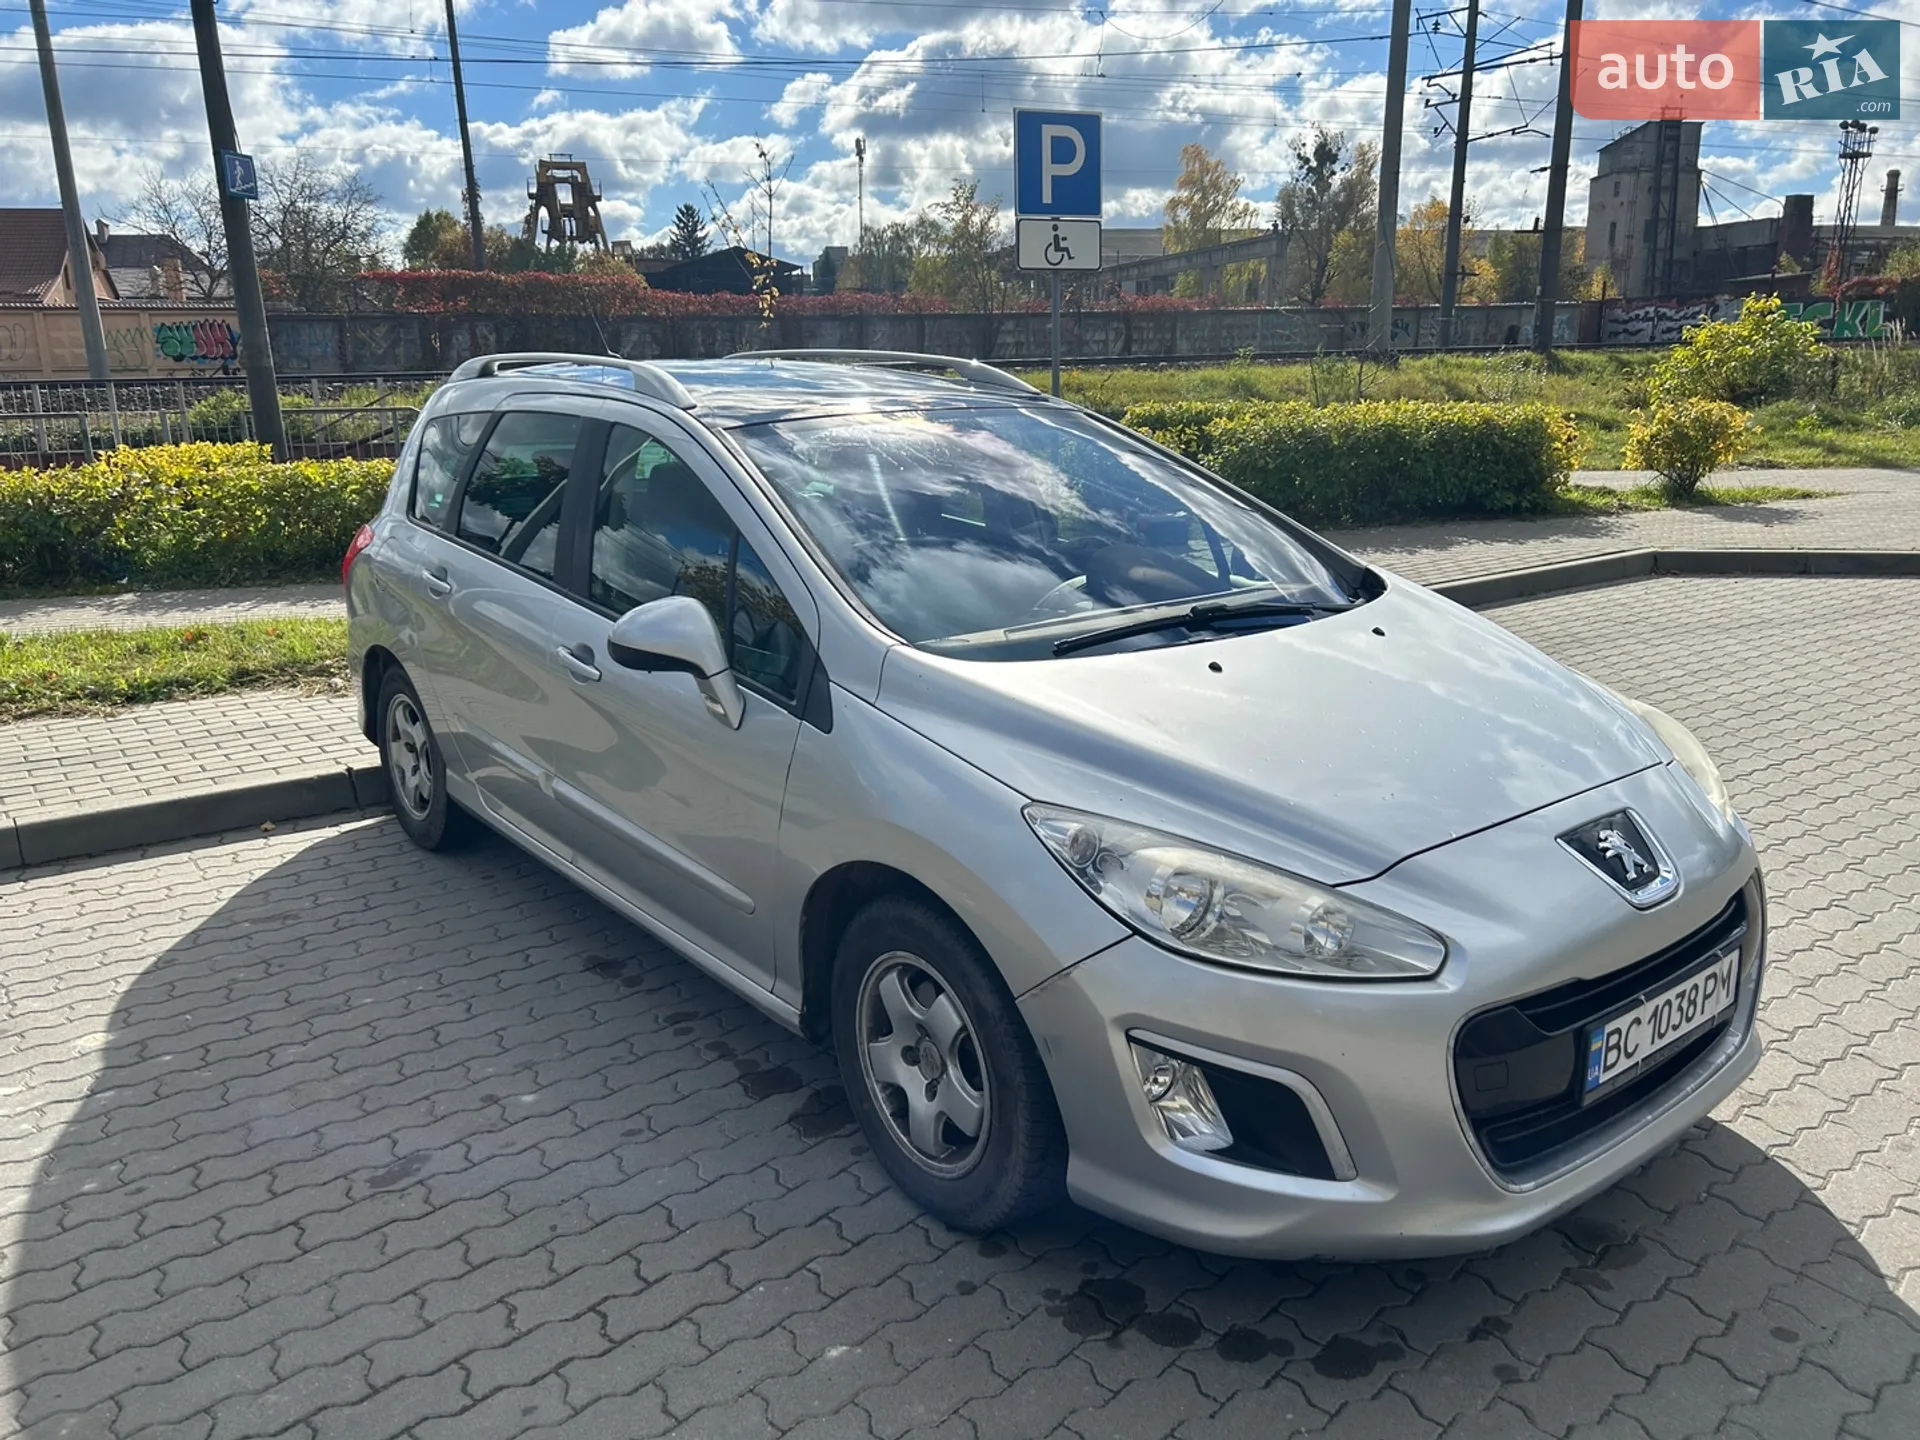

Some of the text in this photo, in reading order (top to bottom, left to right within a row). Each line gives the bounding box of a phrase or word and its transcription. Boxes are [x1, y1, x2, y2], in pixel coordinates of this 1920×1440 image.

[1041, 123, 1086, 204] P
[1602, 1016, 1642, 1074] BC
[1647, 982, 1700, 1046] 1038
[1587, 1065, 1599, 1080] UA
